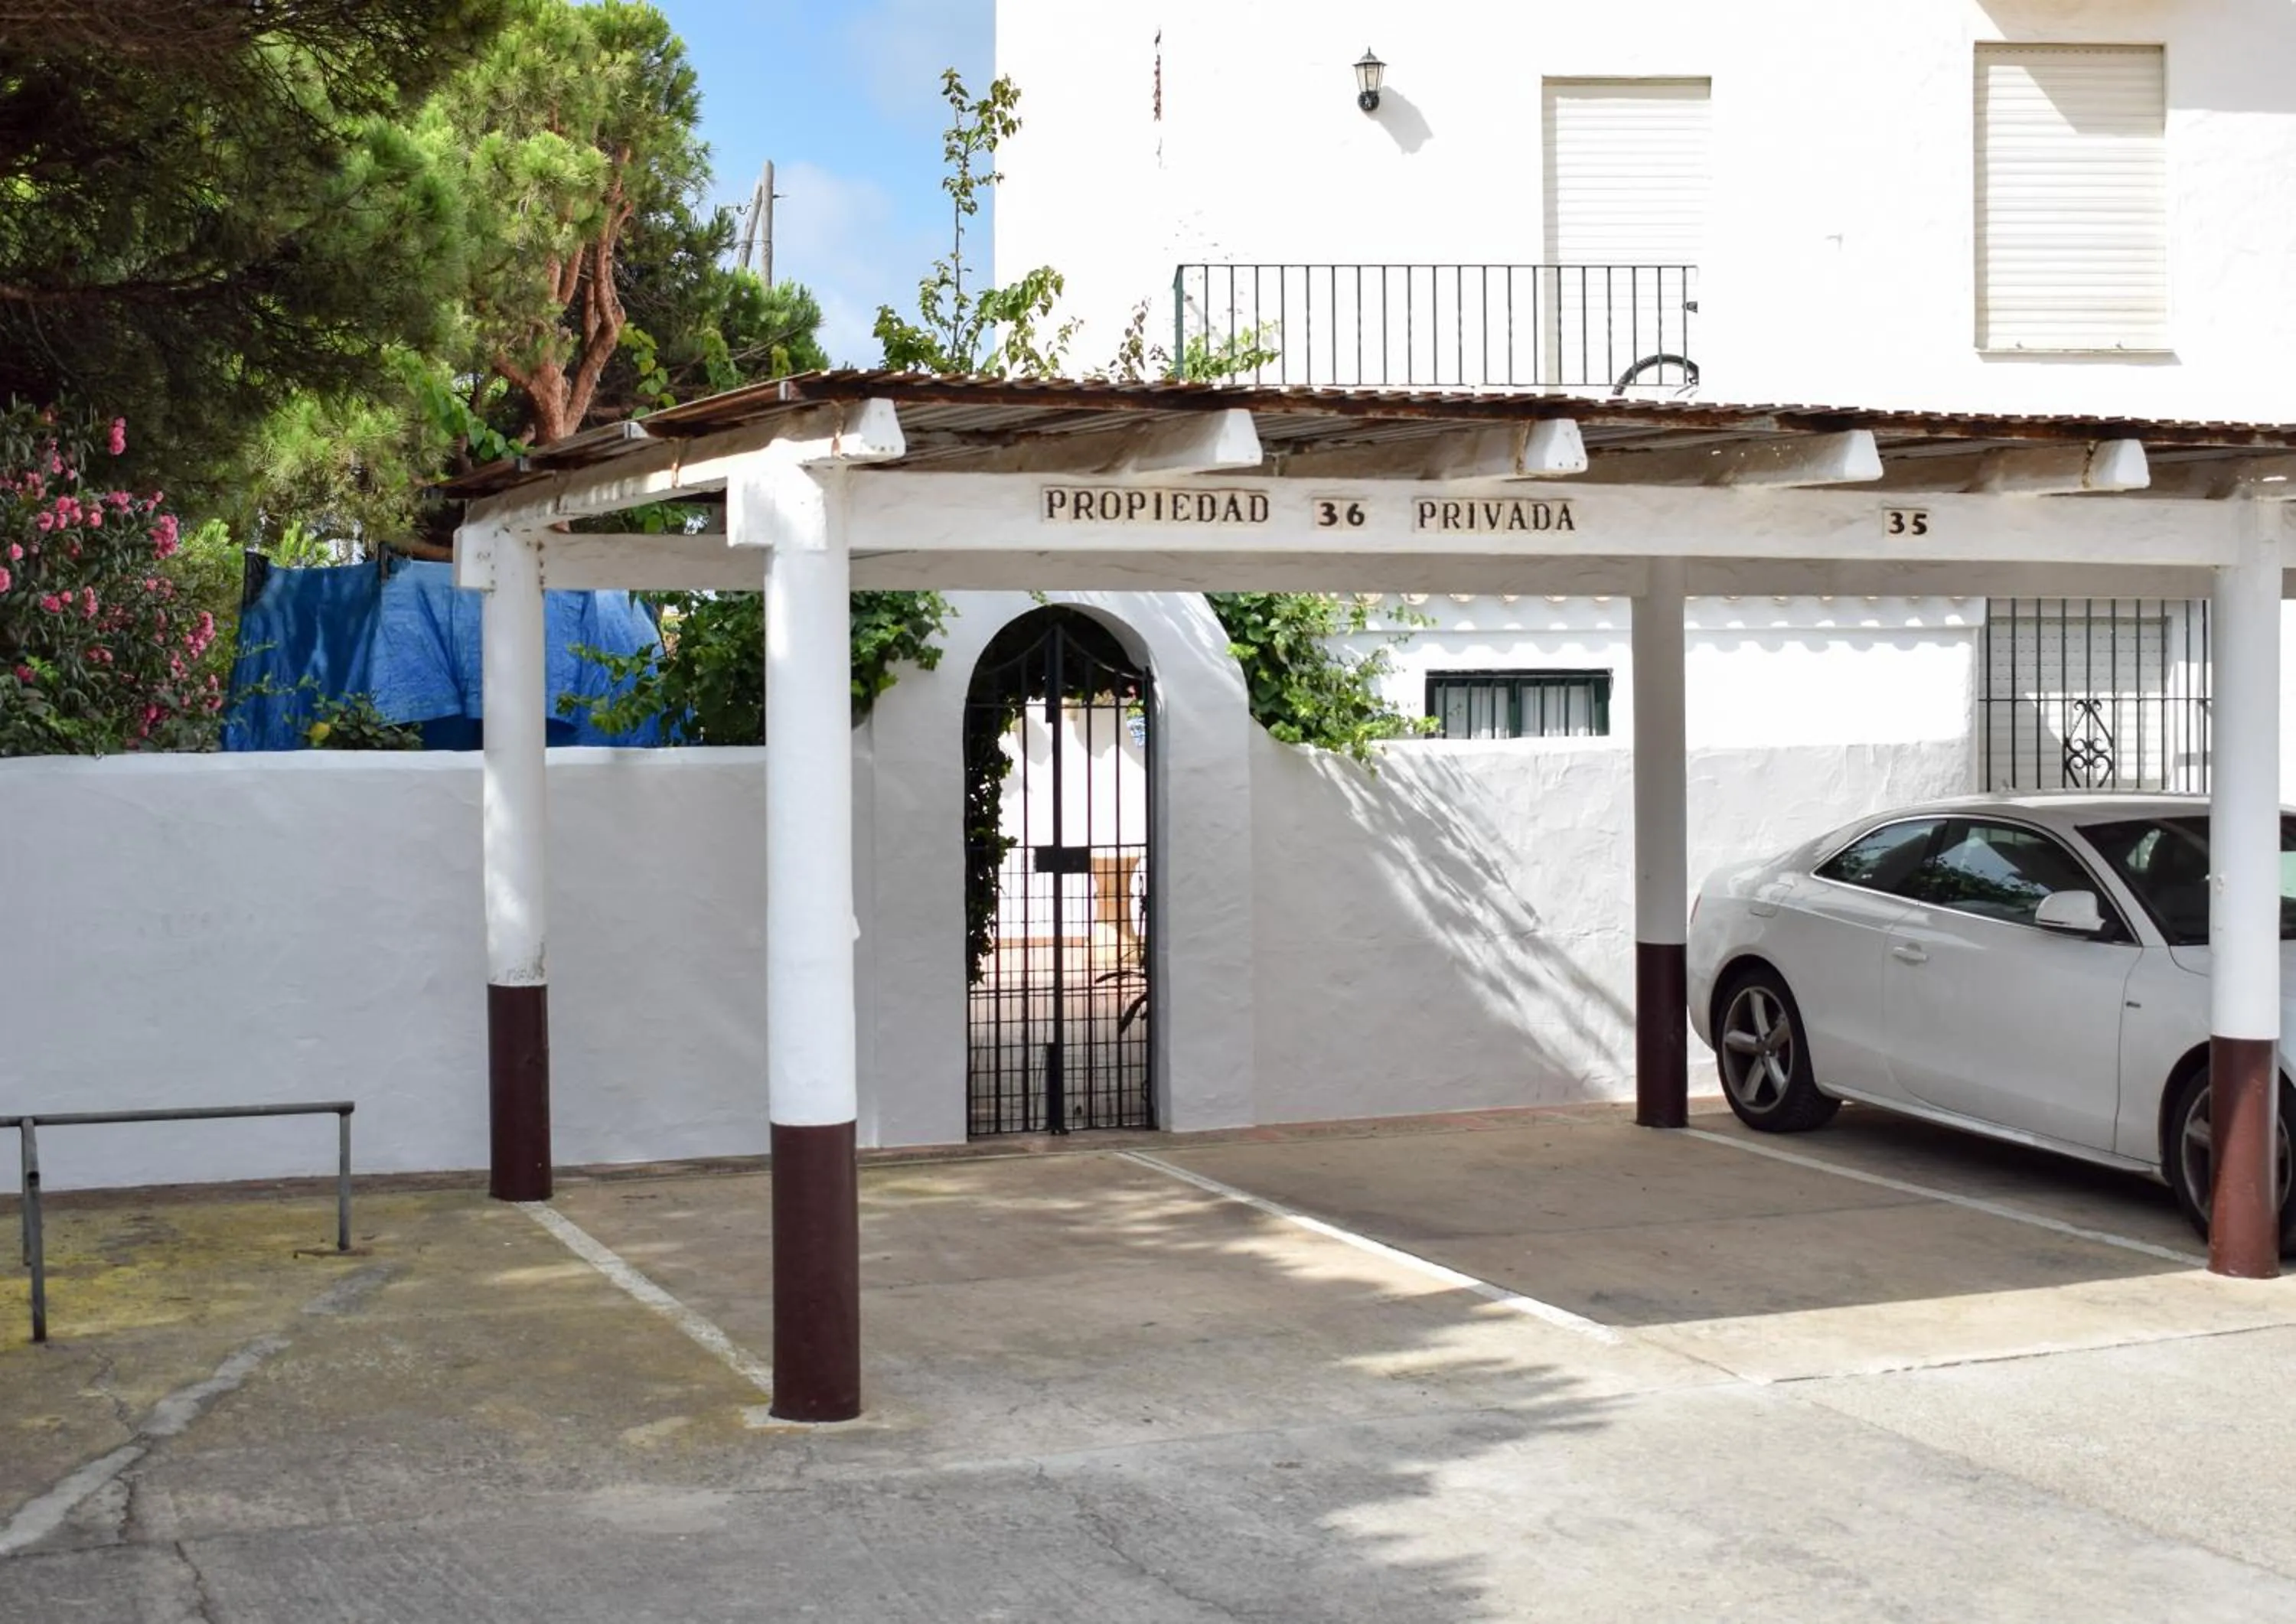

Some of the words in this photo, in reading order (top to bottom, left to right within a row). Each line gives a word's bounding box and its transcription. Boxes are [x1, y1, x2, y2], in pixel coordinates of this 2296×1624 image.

[1045, 490, 1270, 523] PROPIEDAD
[1319, 502, 1365, 527] 36
[1419, 501, 1575, 531] PRIVADA
[1889, 511, 1929, 536] 35
